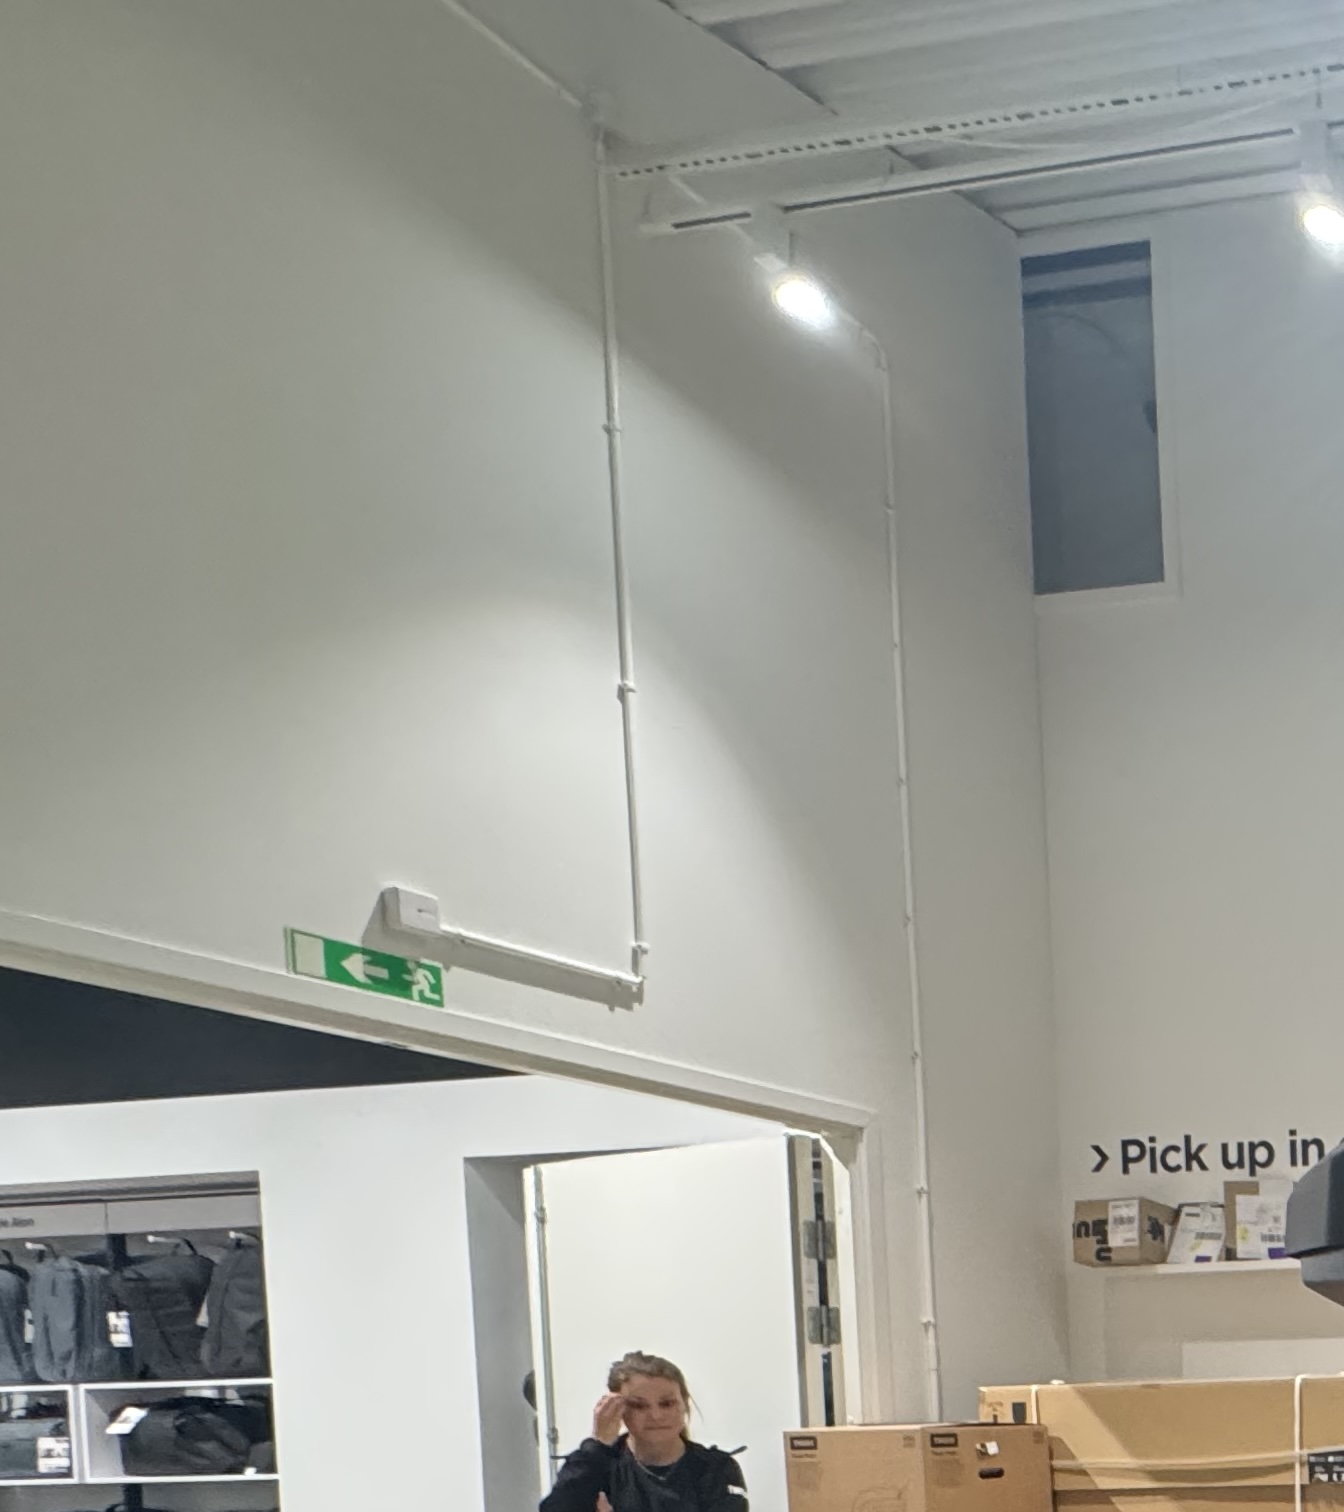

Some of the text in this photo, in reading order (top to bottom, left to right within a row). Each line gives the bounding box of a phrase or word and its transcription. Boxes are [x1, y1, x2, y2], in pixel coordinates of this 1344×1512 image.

[1120, 1129, 1325, 1177] Pick up in
